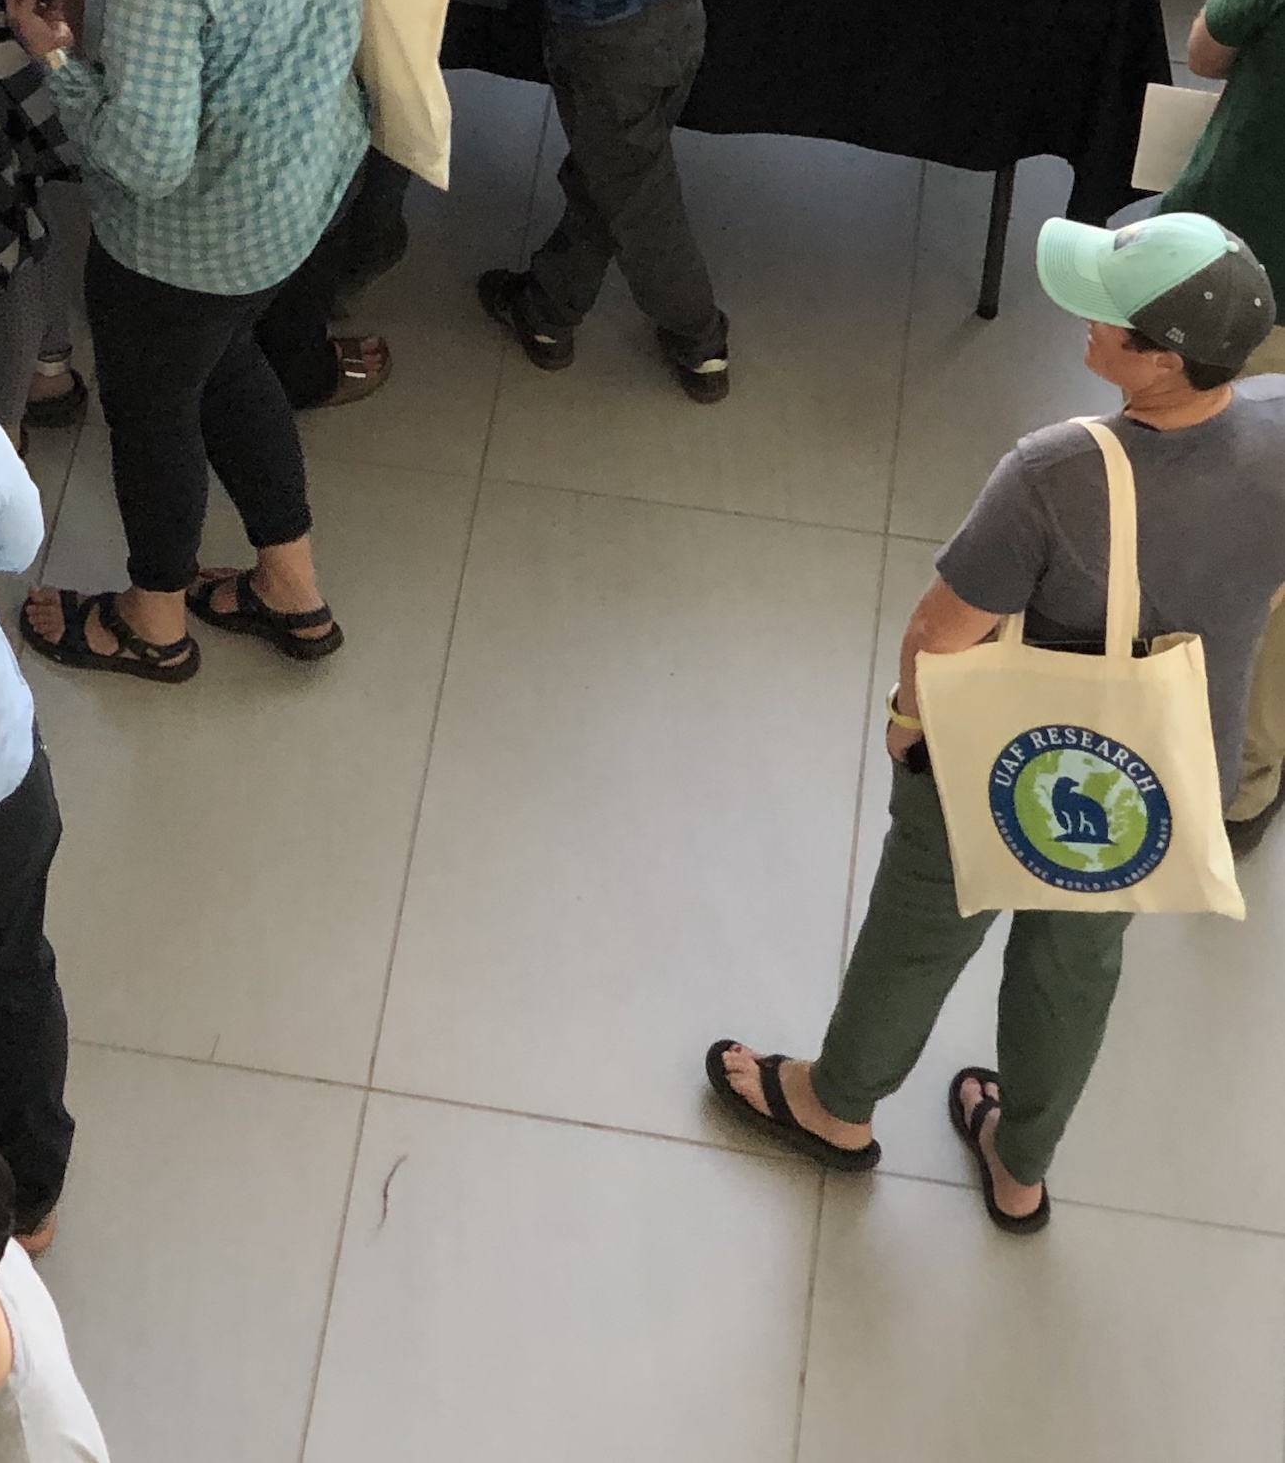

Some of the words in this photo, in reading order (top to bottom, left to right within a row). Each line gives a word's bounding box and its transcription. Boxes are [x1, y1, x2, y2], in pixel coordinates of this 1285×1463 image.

[995, 743, 1026, 787] UAF
[1030, 727, 1157, 793] RESEARCH
[1055, 877, 1101, 891] WORLD
